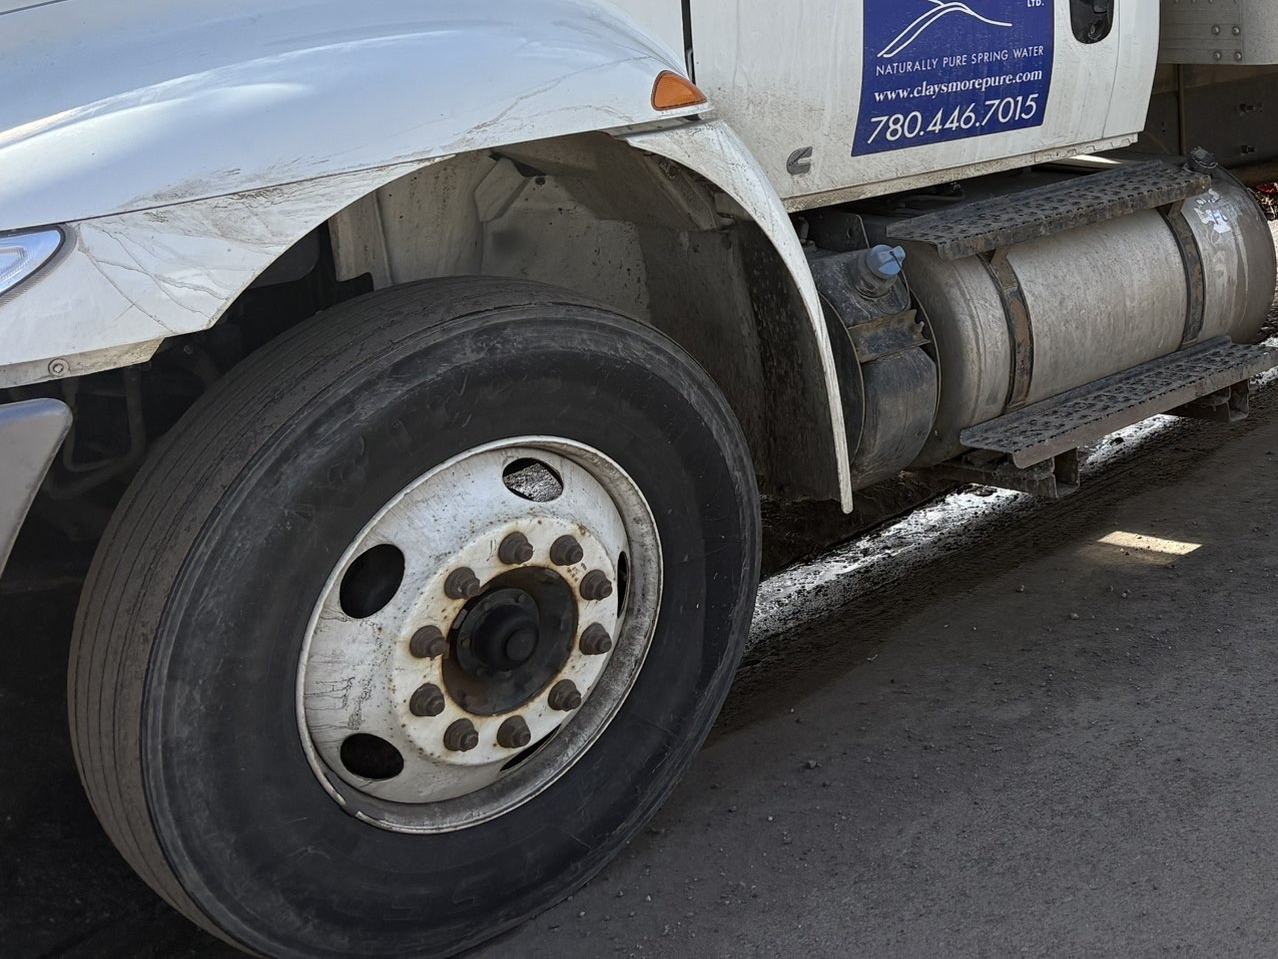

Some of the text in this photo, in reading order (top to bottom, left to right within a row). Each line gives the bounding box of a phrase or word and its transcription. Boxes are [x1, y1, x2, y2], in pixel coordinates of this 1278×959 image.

[875, 45, 1044, 76] NATURALLY PURE SPRING WATER
[874, 70, 1042, 102] www.claysmorepure.com
[867, 94, 1039, 144] 780.446.7015
